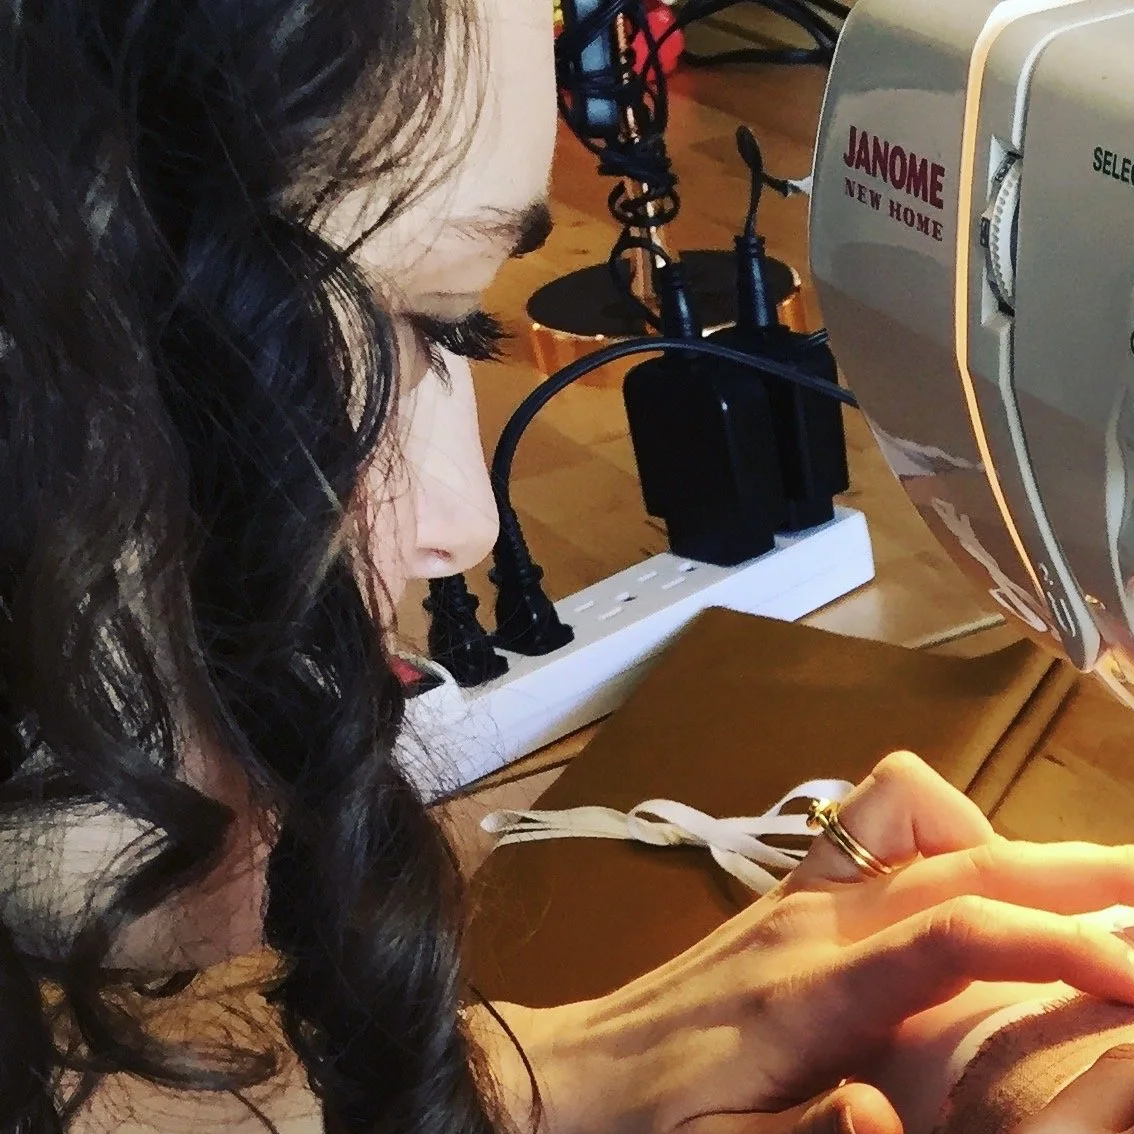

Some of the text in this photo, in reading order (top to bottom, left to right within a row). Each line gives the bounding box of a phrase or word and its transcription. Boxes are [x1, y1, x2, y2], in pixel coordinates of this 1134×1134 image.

[843, 125, 946, 210] JANOME
[844, 176, 944, 242] NEW HOME
